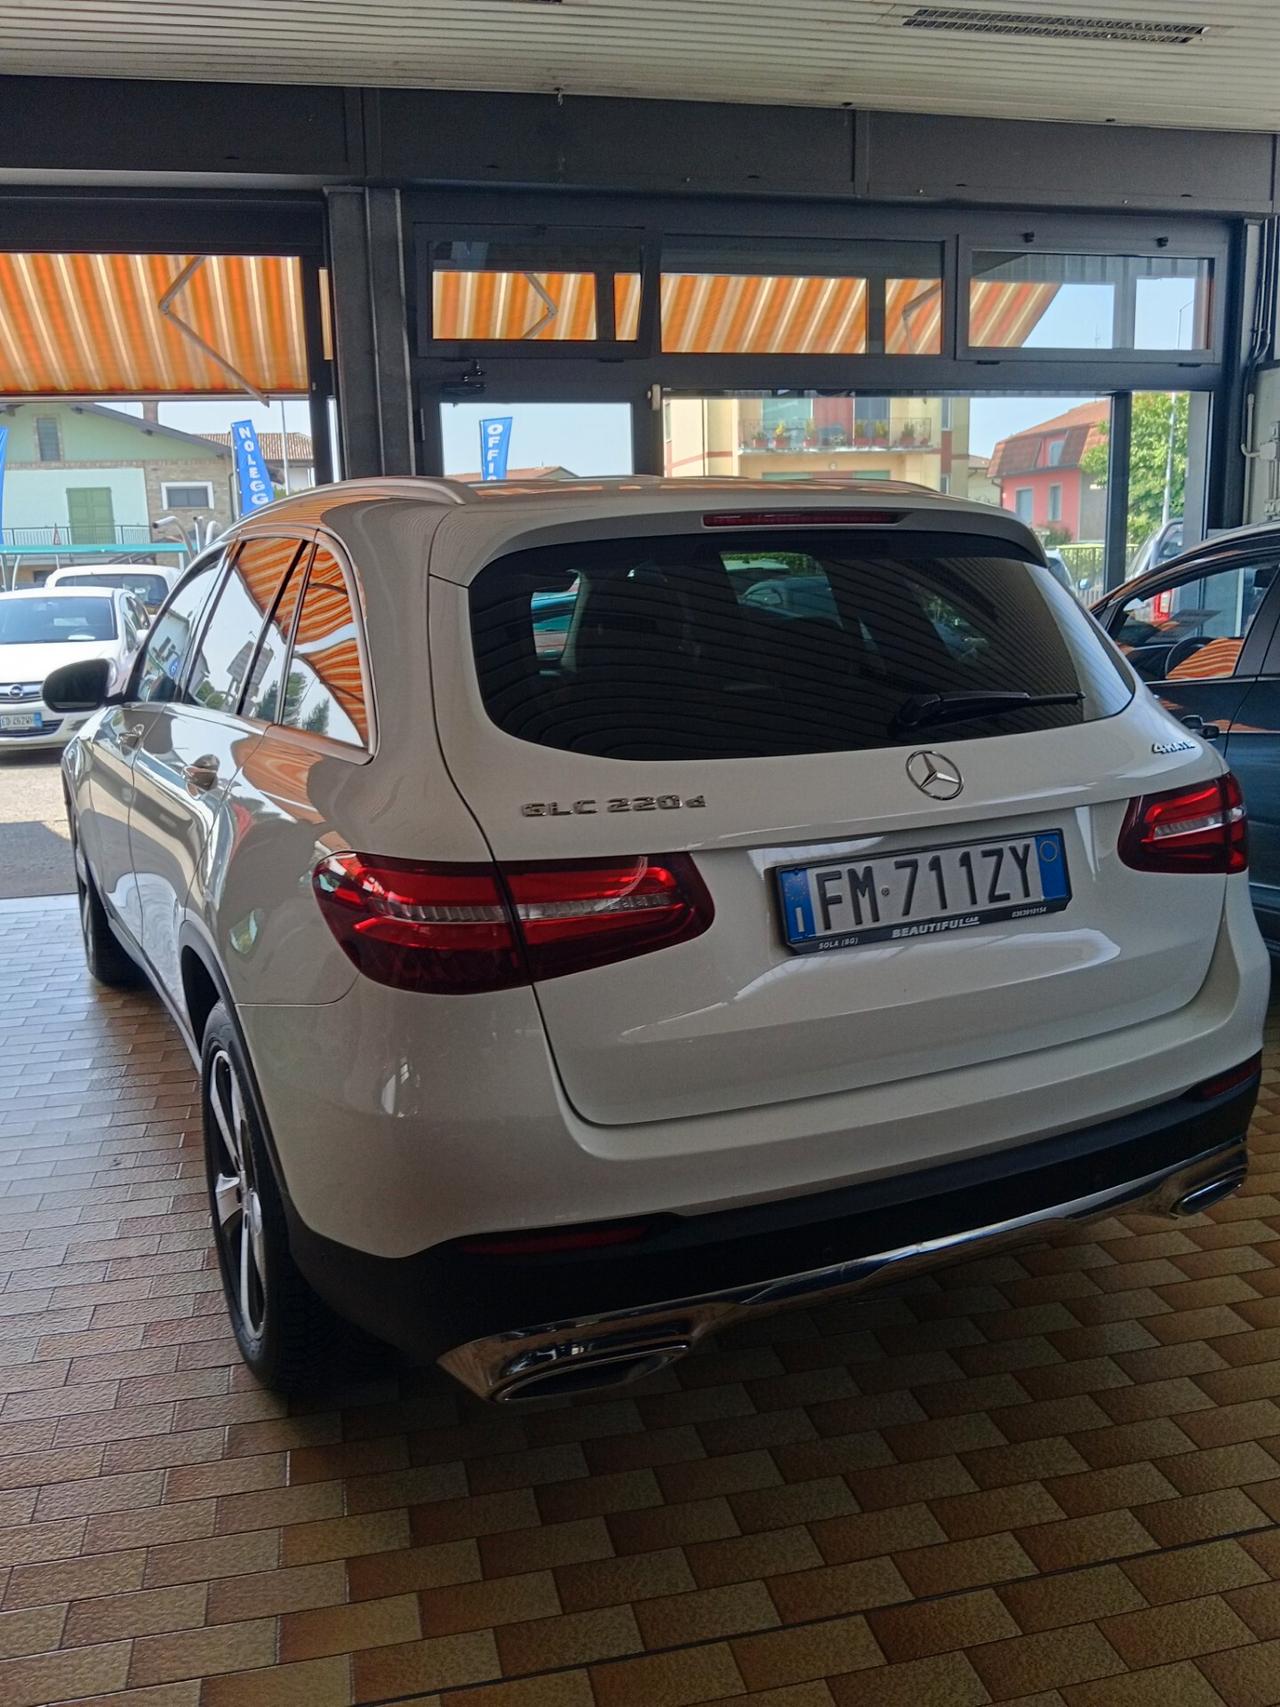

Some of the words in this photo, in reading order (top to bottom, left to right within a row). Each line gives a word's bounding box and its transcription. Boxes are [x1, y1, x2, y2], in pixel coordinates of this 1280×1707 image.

[238, 426, 269, 505] NOLEGG
[521, 799, 598, 817] GLC
[815, 865, 881, 931] FM
[894, 843, 1031, 917] 711ZY
[818, 940, 840, 950] SOLA
[891, 918, 966, 939] BEAUTIFUL
